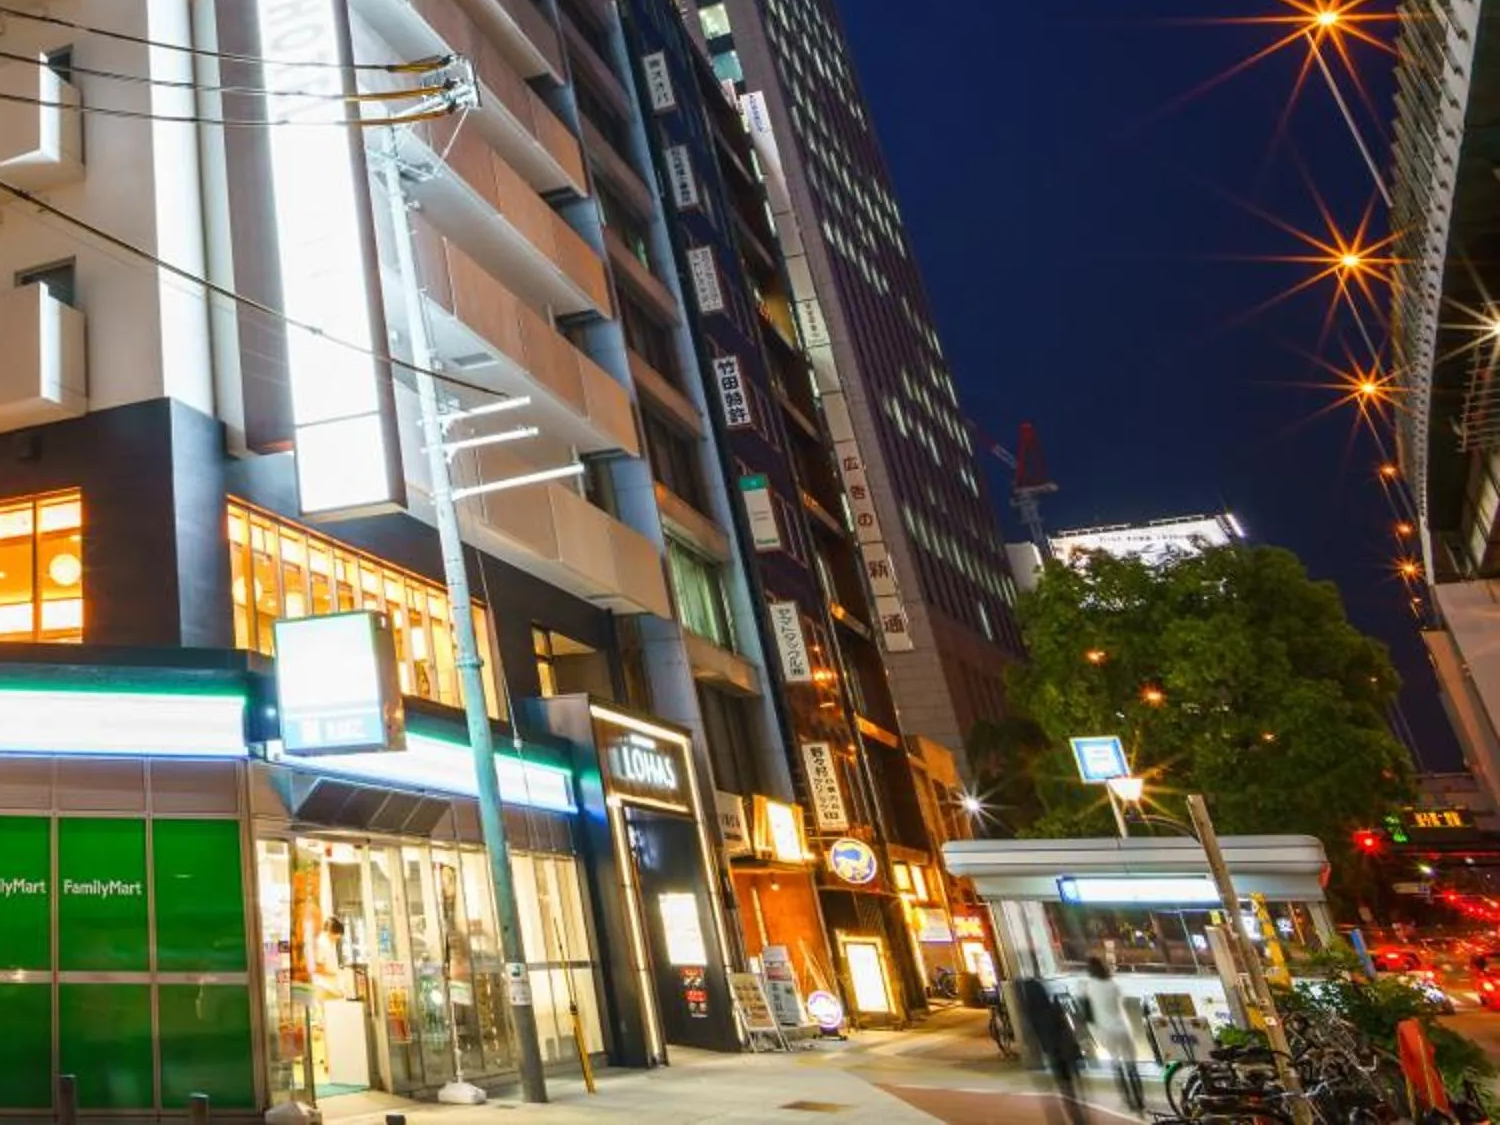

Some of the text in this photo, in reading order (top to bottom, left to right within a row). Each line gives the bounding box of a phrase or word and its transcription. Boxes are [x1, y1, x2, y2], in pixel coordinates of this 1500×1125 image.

[843, 457, 904, 633] 広告の新通
[622, 746, 676, 788] LOHAS
[64, 879, 142, 899] FamilyMart
